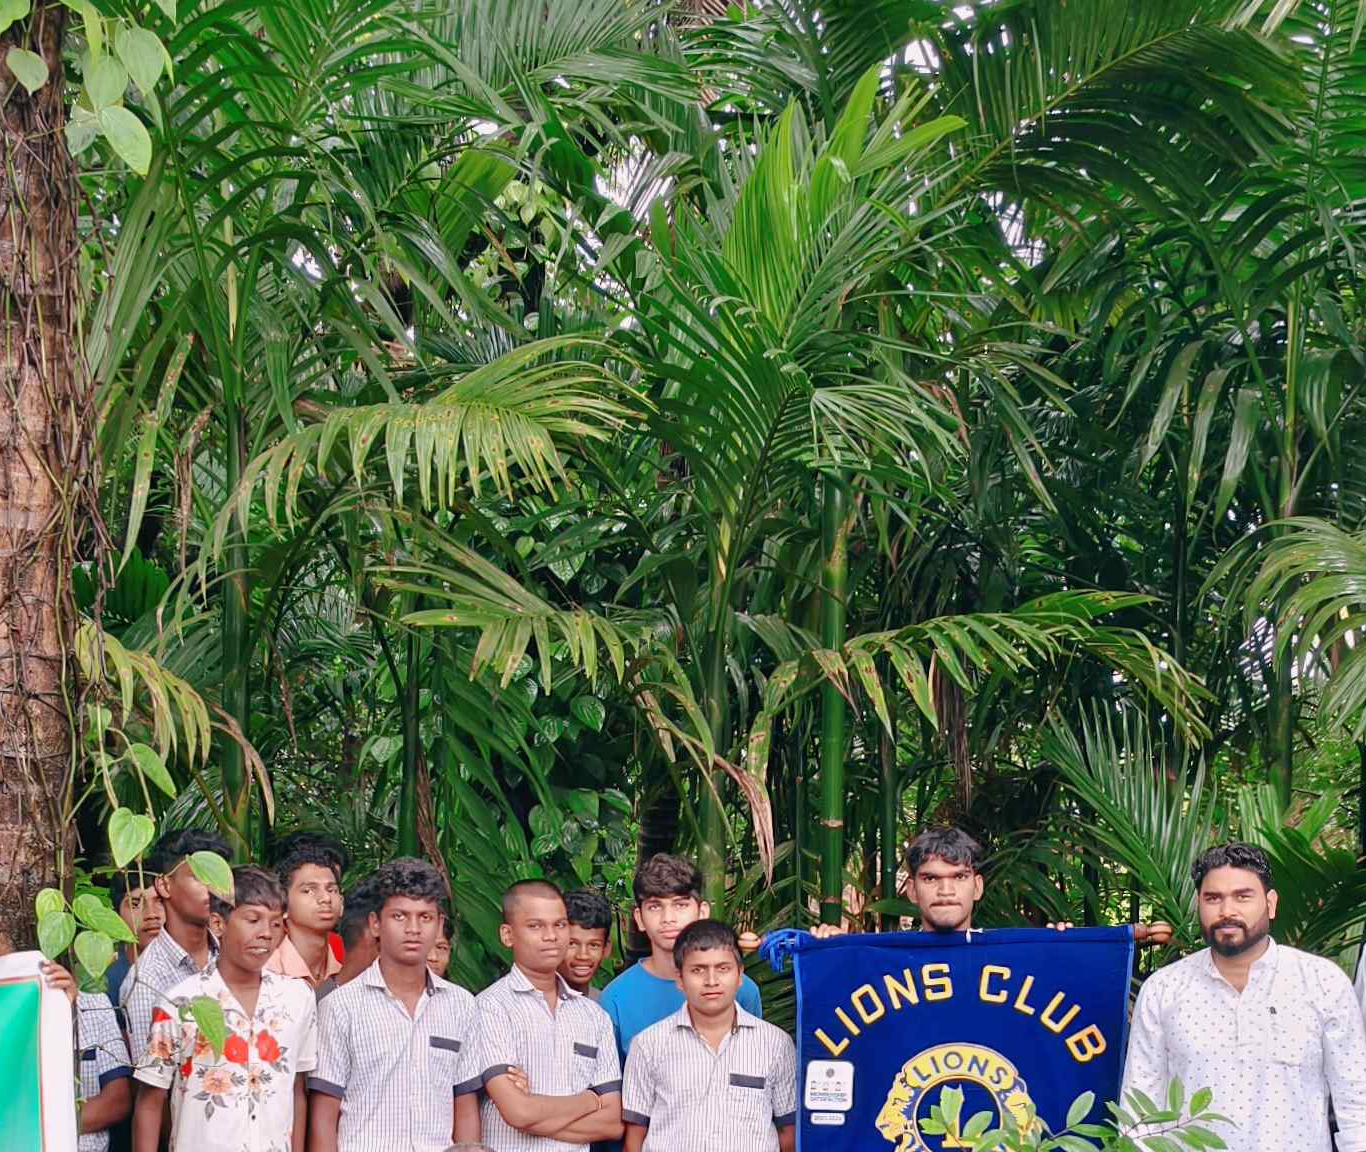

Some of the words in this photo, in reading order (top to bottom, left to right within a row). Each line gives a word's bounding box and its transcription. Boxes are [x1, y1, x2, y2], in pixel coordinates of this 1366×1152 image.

[814, 963, 953, 1057] LIONS
[979, 964, 1107, 1063] CLUB
[912, 1051, 1008, 1085] LIONS
